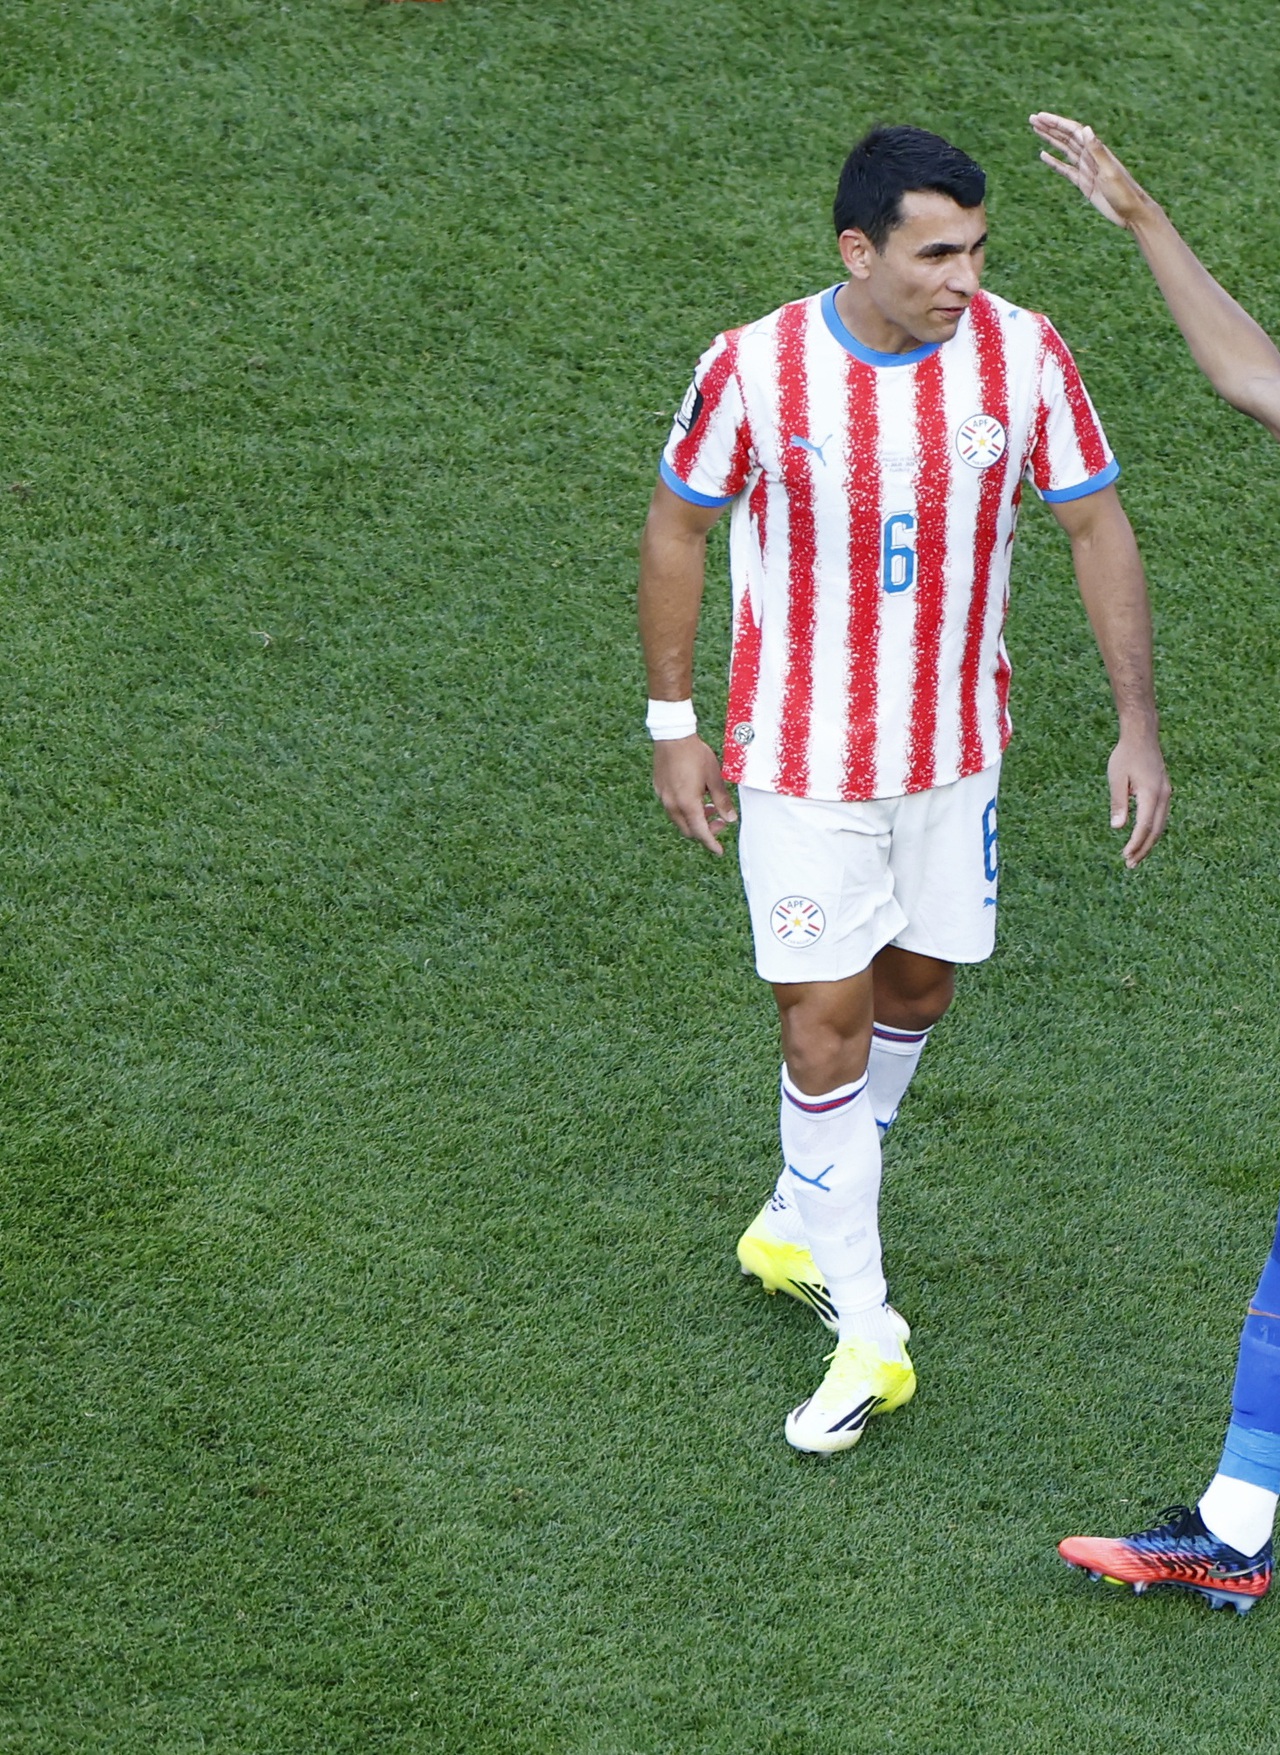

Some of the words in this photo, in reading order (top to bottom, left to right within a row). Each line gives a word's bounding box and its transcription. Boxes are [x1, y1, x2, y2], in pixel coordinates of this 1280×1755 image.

[973, 419, 988, 427] APF
[881, 510, 917, 596] 6
[787, 900, 804, 908] APF
